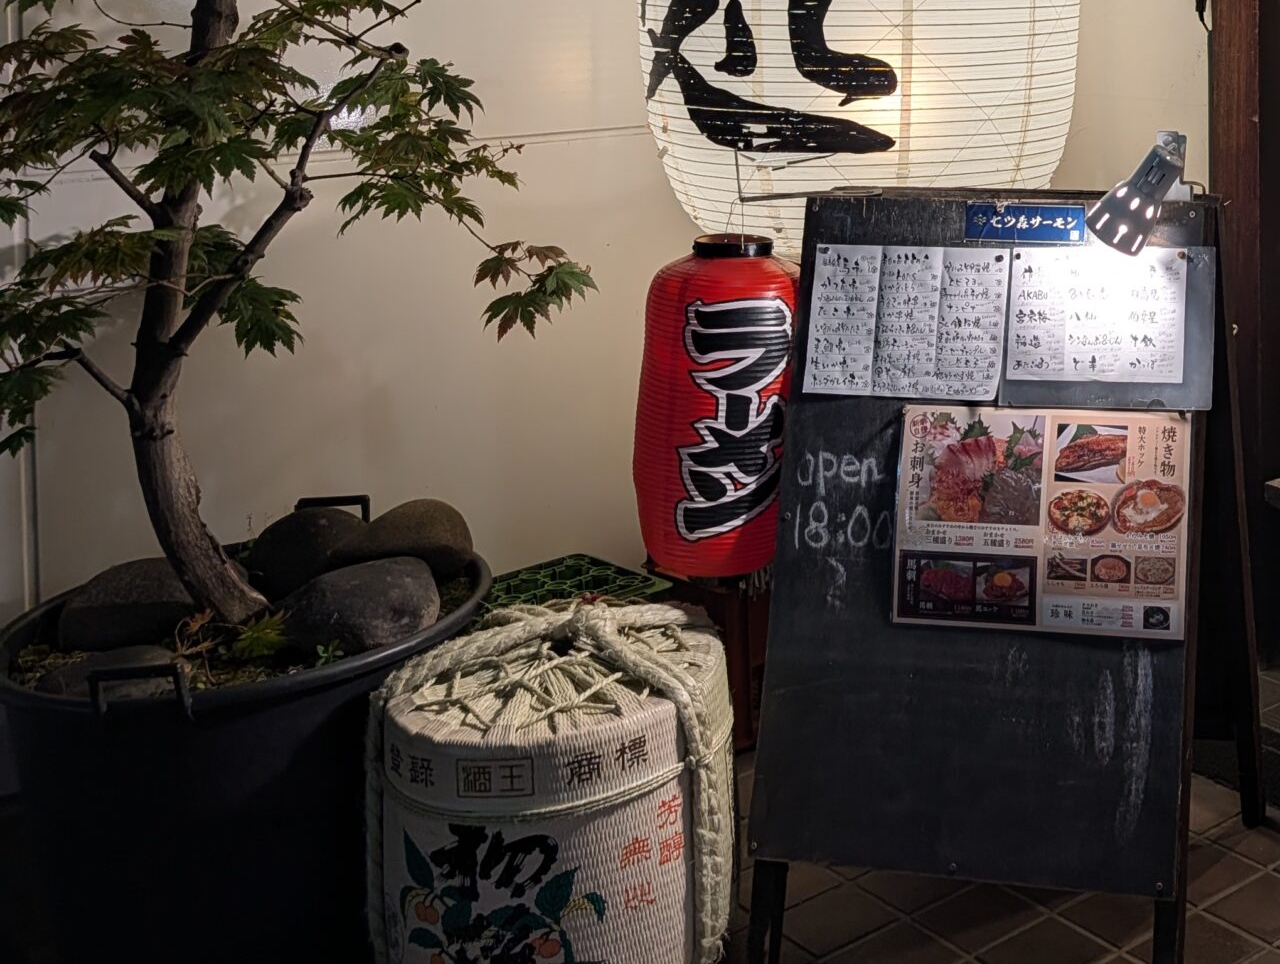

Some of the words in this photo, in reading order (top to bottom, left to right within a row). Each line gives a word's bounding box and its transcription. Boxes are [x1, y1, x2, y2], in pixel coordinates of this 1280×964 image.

[990, 214, 1078, 230] 七ツ森サーモン
[1017, 290, 1048, 301] AKABU
[674, 298, 793, 542] ラーメン
[908, 441, 926, 489] お刺身
[1137, 426, 1147, 469] 特大ホッケ
[1160, 425, 1178, 477] 焼き物
[797, 449, 885, 497] open
[1050, 609, 1074, 620] 珍味
[388, 744, 436, 788] 登録
[460, 762, 527, 795] 酒王
[565, 734, 649, 788] 商標
[656, 795, 686, 866] 芳醇
